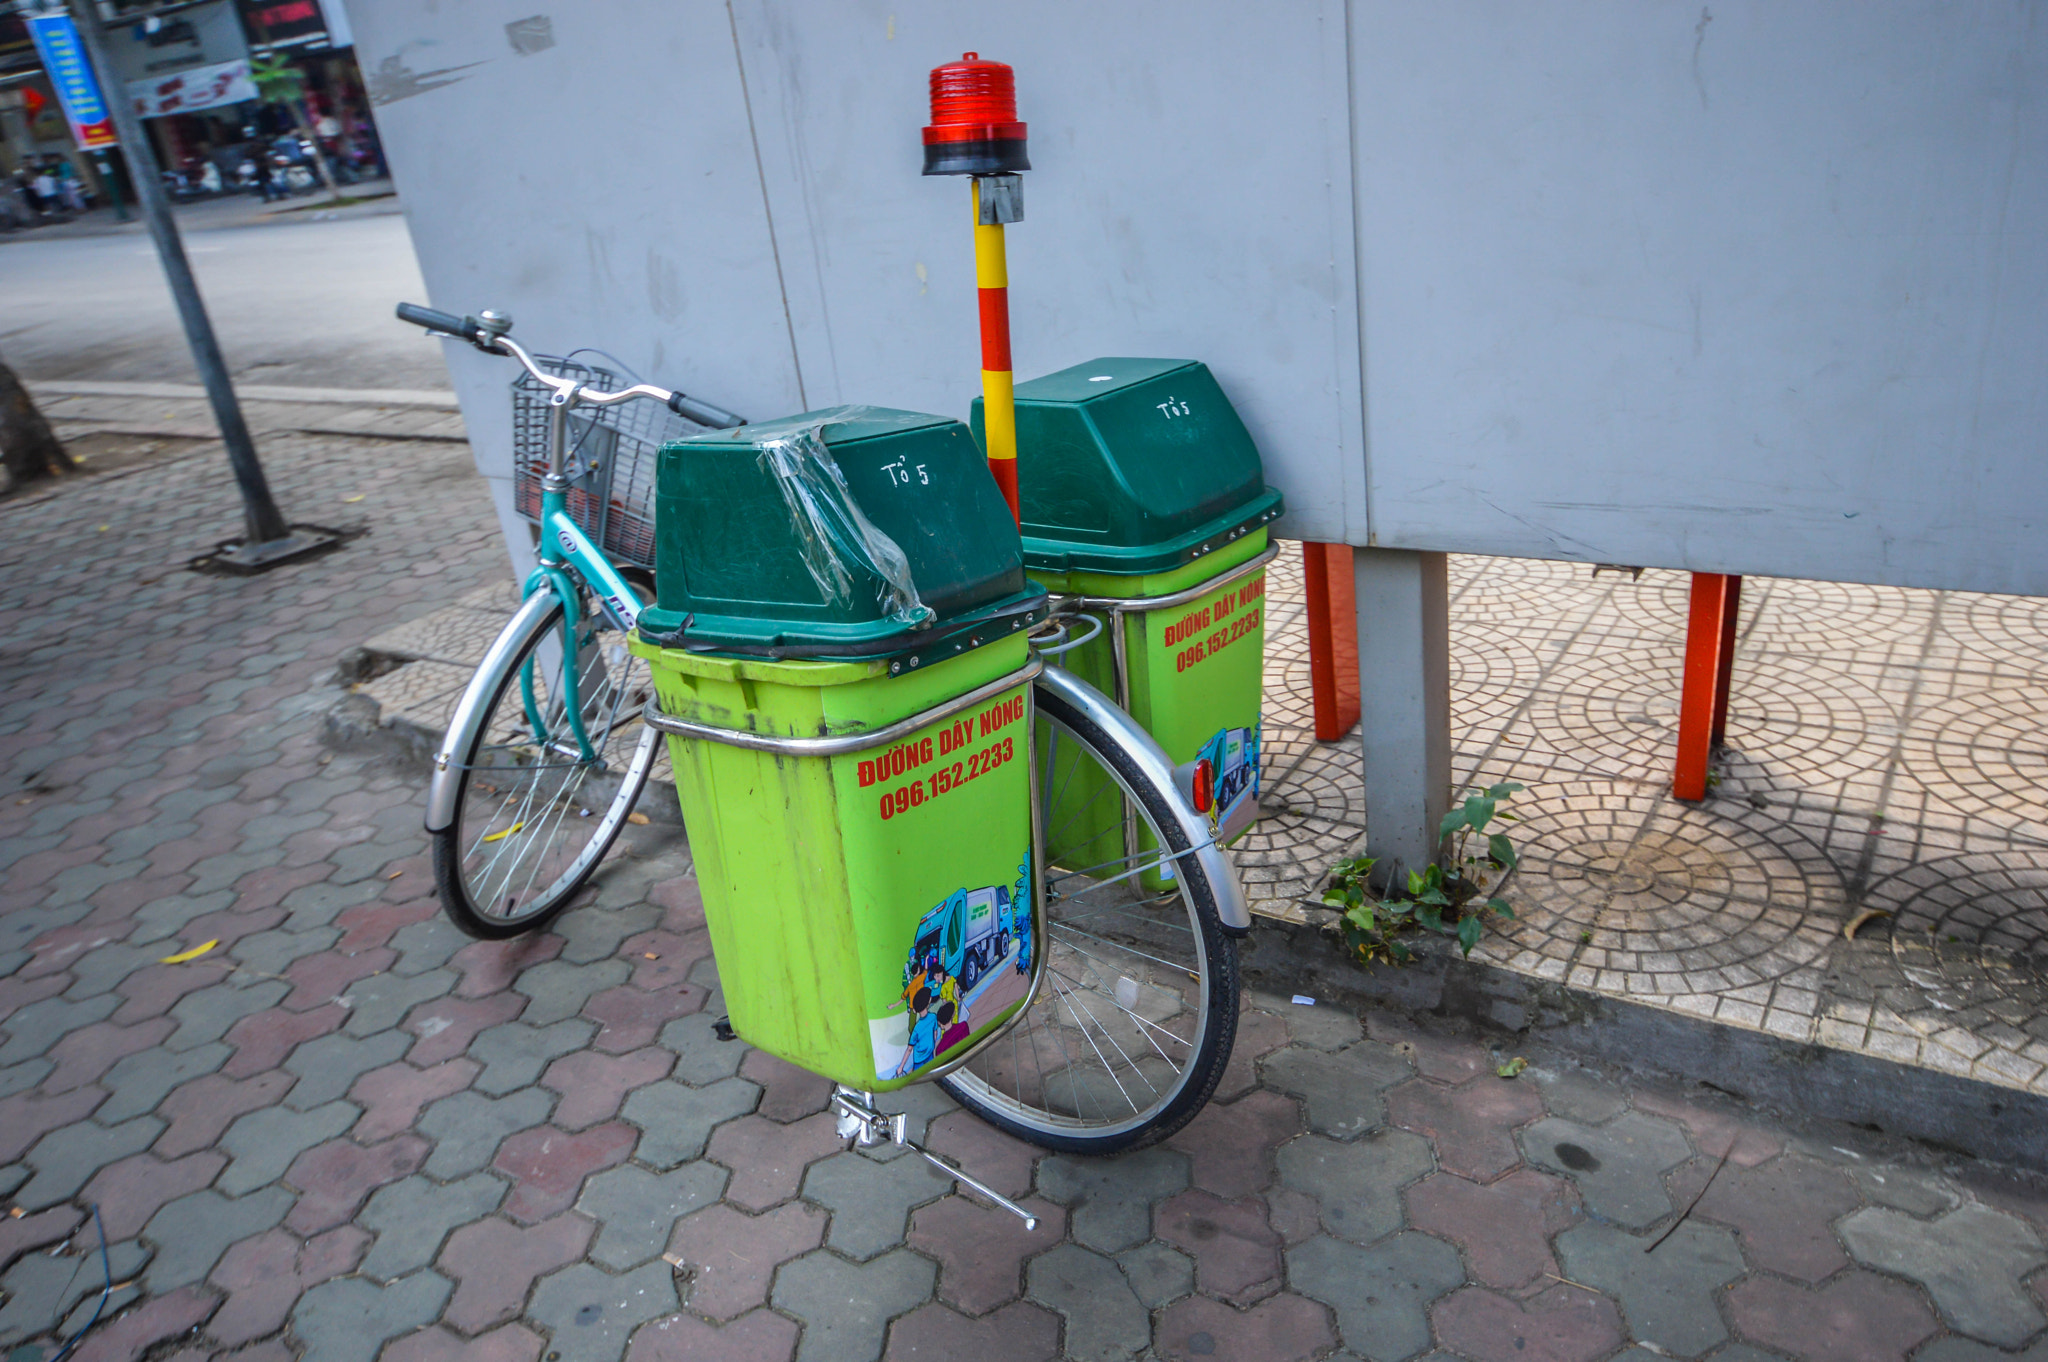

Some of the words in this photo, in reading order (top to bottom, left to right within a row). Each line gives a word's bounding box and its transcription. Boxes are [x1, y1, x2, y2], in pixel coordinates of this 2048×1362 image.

[1180, 401, 1190, 415] 5
[880, 455, 909, 488] Tổ
[916, 464, 929, 485] 5
[1164, 607, 1210, 648] ĐƯỜNG
[1214, 593, 1236, 623] DÂY
[1177, 608, 1260, 673] 096.152.2233
[857, 737, 933, 788] ĐƯỜNG
[939, 717, 974, 756] DÂY
[979, 694, 1024, 738] NÓNG
[880, 737, 1014, 821] 096.152.2233
